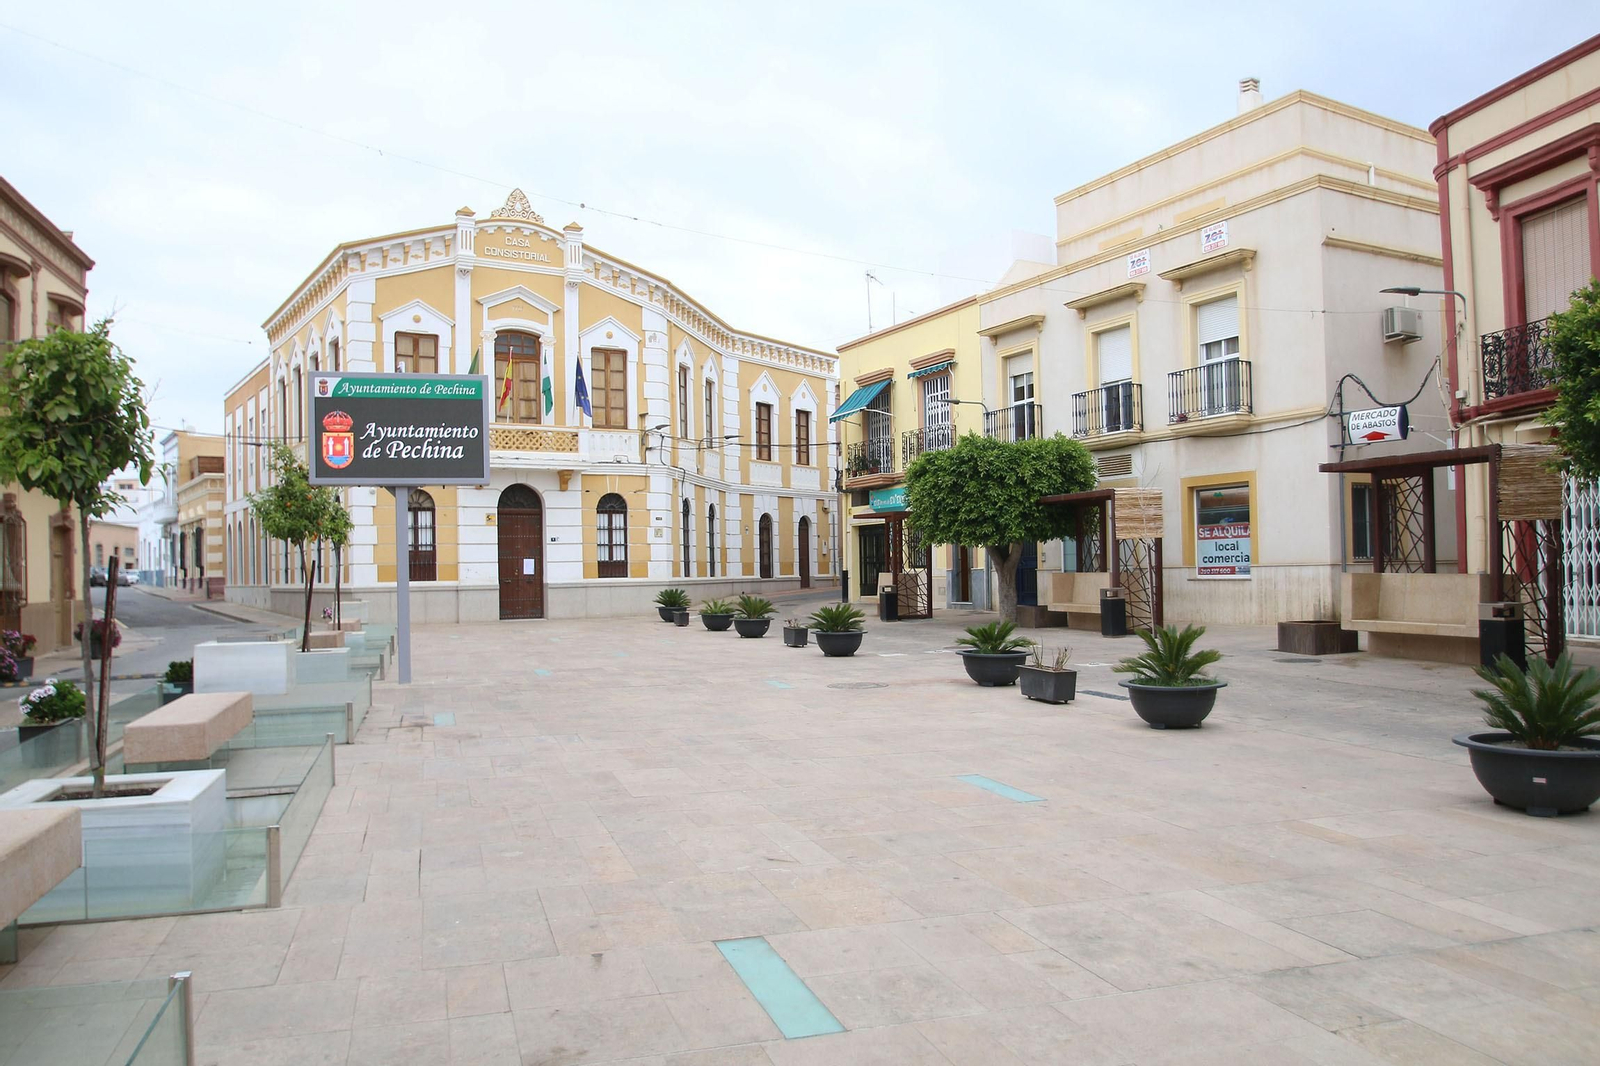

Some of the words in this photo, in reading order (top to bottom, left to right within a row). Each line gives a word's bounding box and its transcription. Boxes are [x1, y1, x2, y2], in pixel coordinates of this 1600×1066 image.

[505, 236, 531, 248] CASA
[484, 246, 551, 263] CONSISTORIAL
[338, 382, 417, 396] Ayuntamiento
[419, 383, 432, 395] de
[434, 383, 476, 395] Pechina
[1352, 408, 1398, 421] MERCADO
[1351, 423, 1361, 431] DE
[1362, 419, 1397, 430] ABASTOS
[359, 422, 479, 444] Ayuntamiento
[362, 441, 381, 459] de
[386, 438, 465, 459] Pechina
[1198, 527, 1211, 538] SE
[1215, 540, 1239, 552] local
